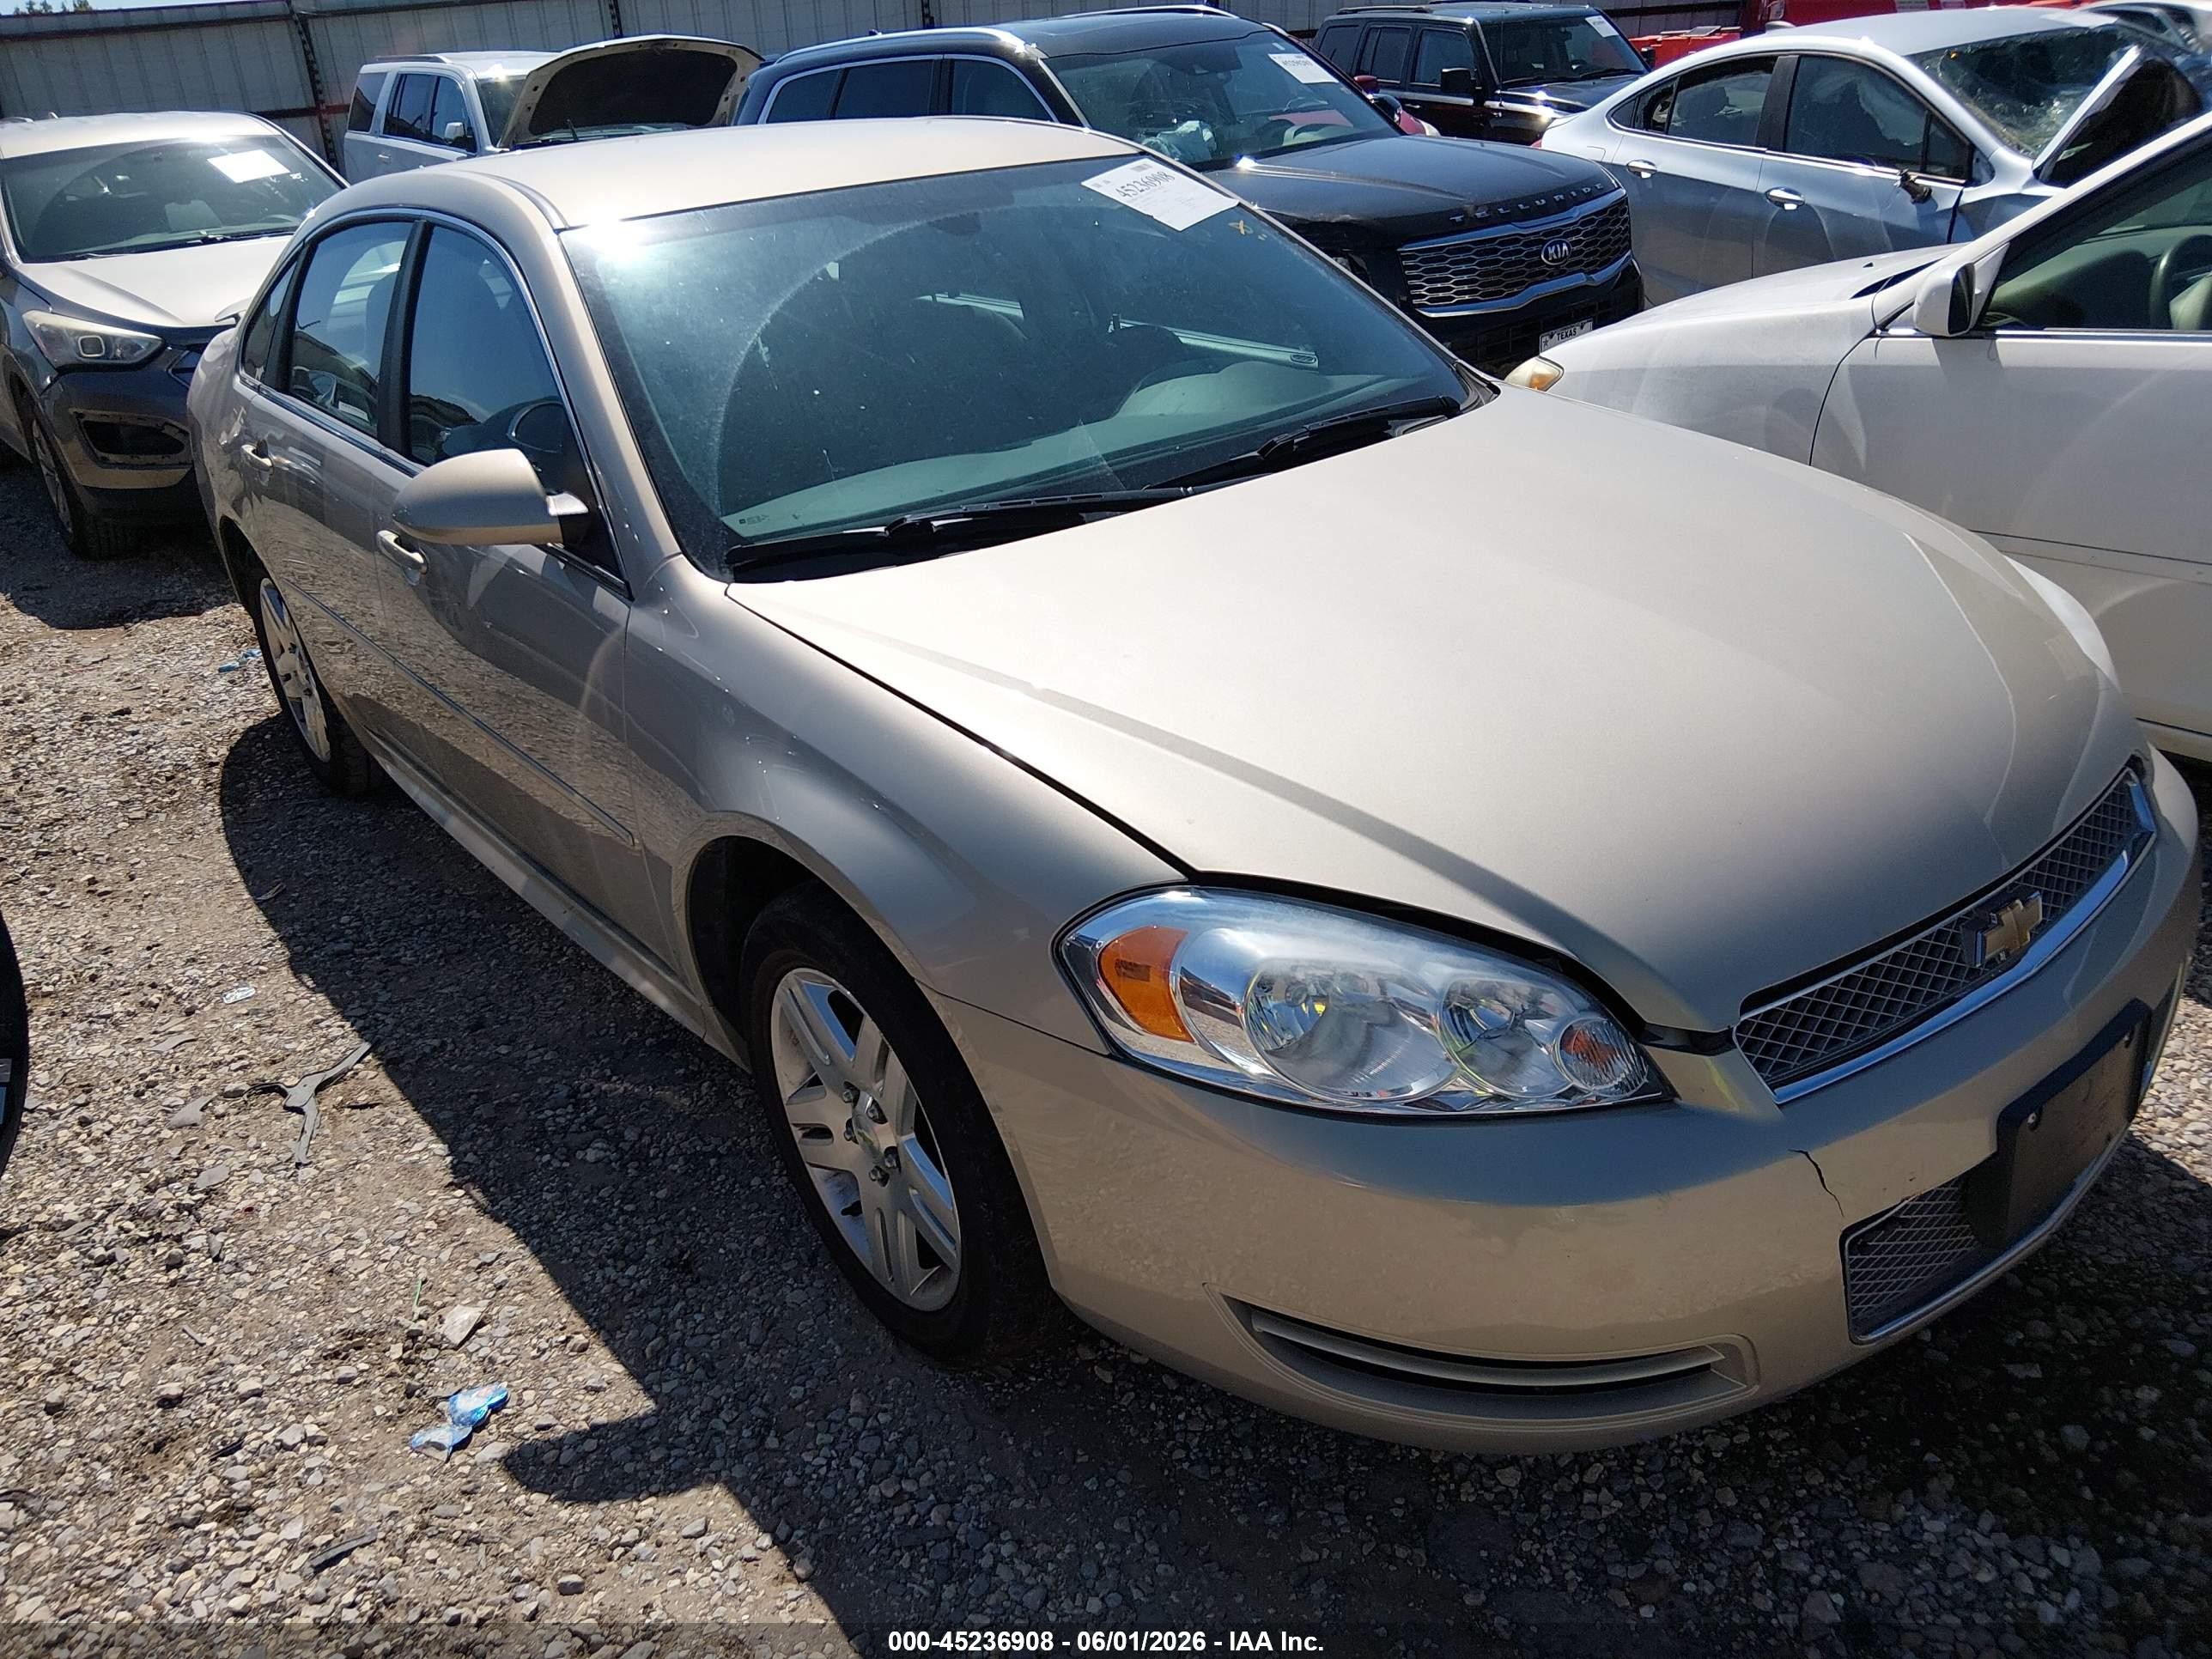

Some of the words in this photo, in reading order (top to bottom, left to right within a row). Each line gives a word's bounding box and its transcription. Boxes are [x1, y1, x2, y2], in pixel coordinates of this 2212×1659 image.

[1449, 183, 1604, 222] TELLURIDE
[1547, 242, 1570, 261] KIA
[1556, 328, 1577, 340] TEXAS
